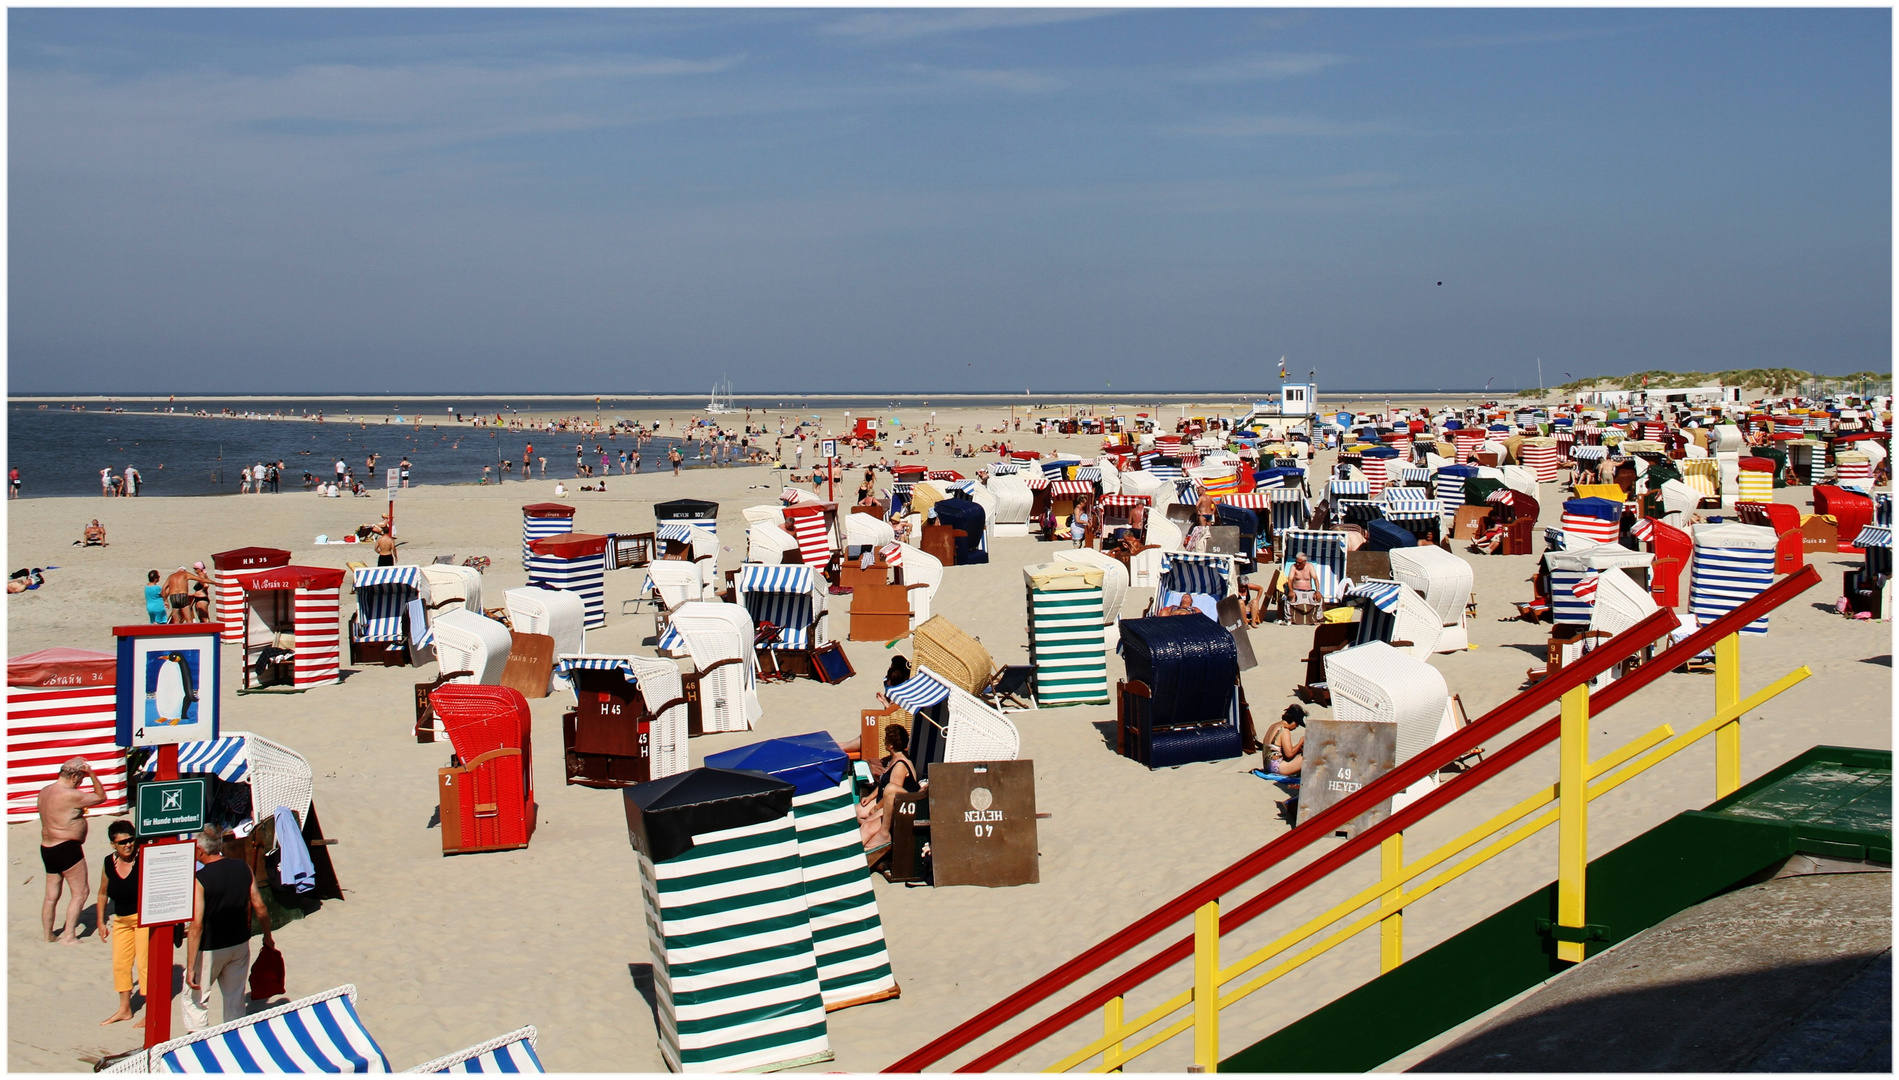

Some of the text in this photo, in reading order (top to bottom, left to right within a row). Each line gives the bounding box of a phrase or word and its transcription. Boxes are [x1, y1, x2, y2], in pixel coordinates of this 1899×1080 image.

[658, 622, 666, 631] H
[1550, 653, 1558, 664] H
[91, 673, 104, 681] 34
[688, 691, 697, 702] H
[420, 698, 428, 708] H
[601, 703, 622, 715] H 45
[866, 715, 876, 726] 16
[135, 728, 144, 739] 4
[639, 733, 647, 744] 45
[641, 746, 649, 758] H
[1338, 767, 1351, 779] 49
[445, 774, 452, 786] 2
[1328, 780, 1363, 793] HEYEN
[899, 802, 916, 815] 40
[143, 813, 200, 826] für Hunde verboten!
[964, 810, 1004, 822] HEYEN
[974, 824, 994, 838] 40
